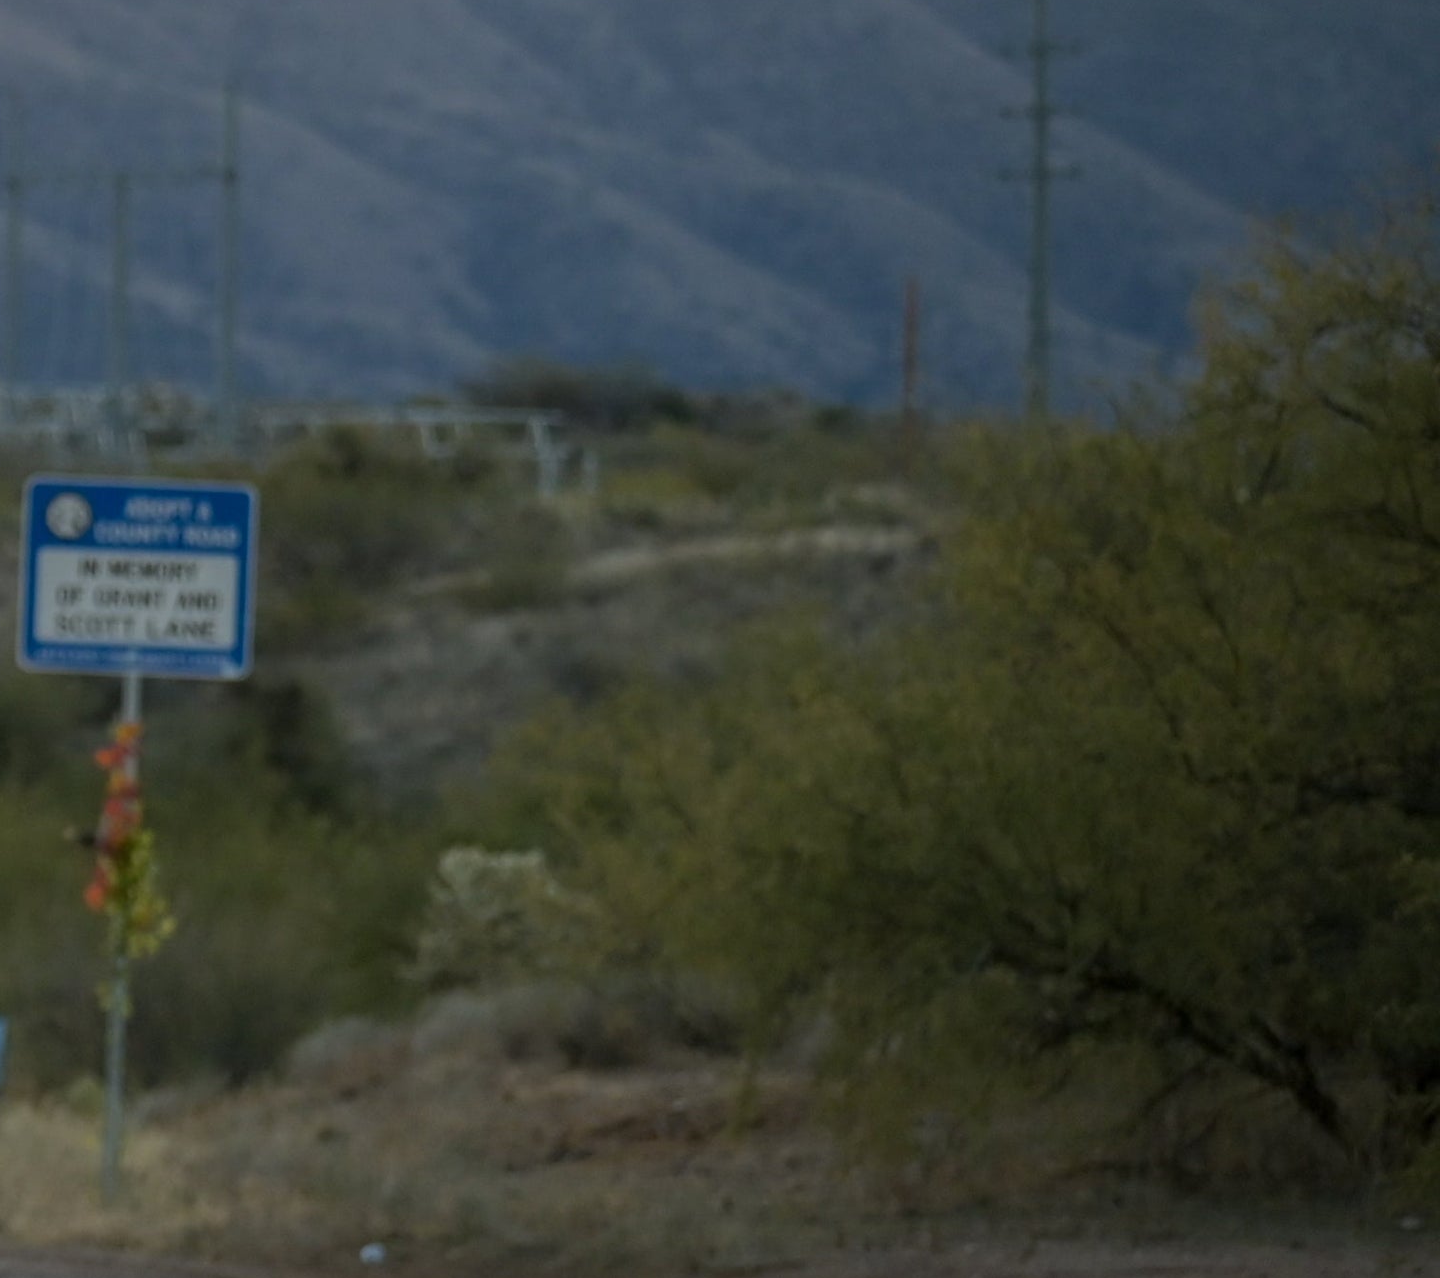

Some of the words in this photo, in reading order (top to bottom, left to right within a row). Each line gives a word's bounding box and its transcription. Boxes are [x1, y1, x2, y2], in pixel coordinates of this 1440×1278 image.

[125, 496, 192, 520] ADOPT
[93, 521, 179, 544] COUNTY
[183, 526, 240, 548] ROAD
[79, 559, 98, 577] IN
[107, 560, 197, 582] MEMORY
[55, 586, 82, 605] OF
[94, 588, 165, 609] GRANT
[176, 591, 219, 612] AND
[55, 615, 134, 636] SCOTT
[146, 619, 217, 643] LANE
